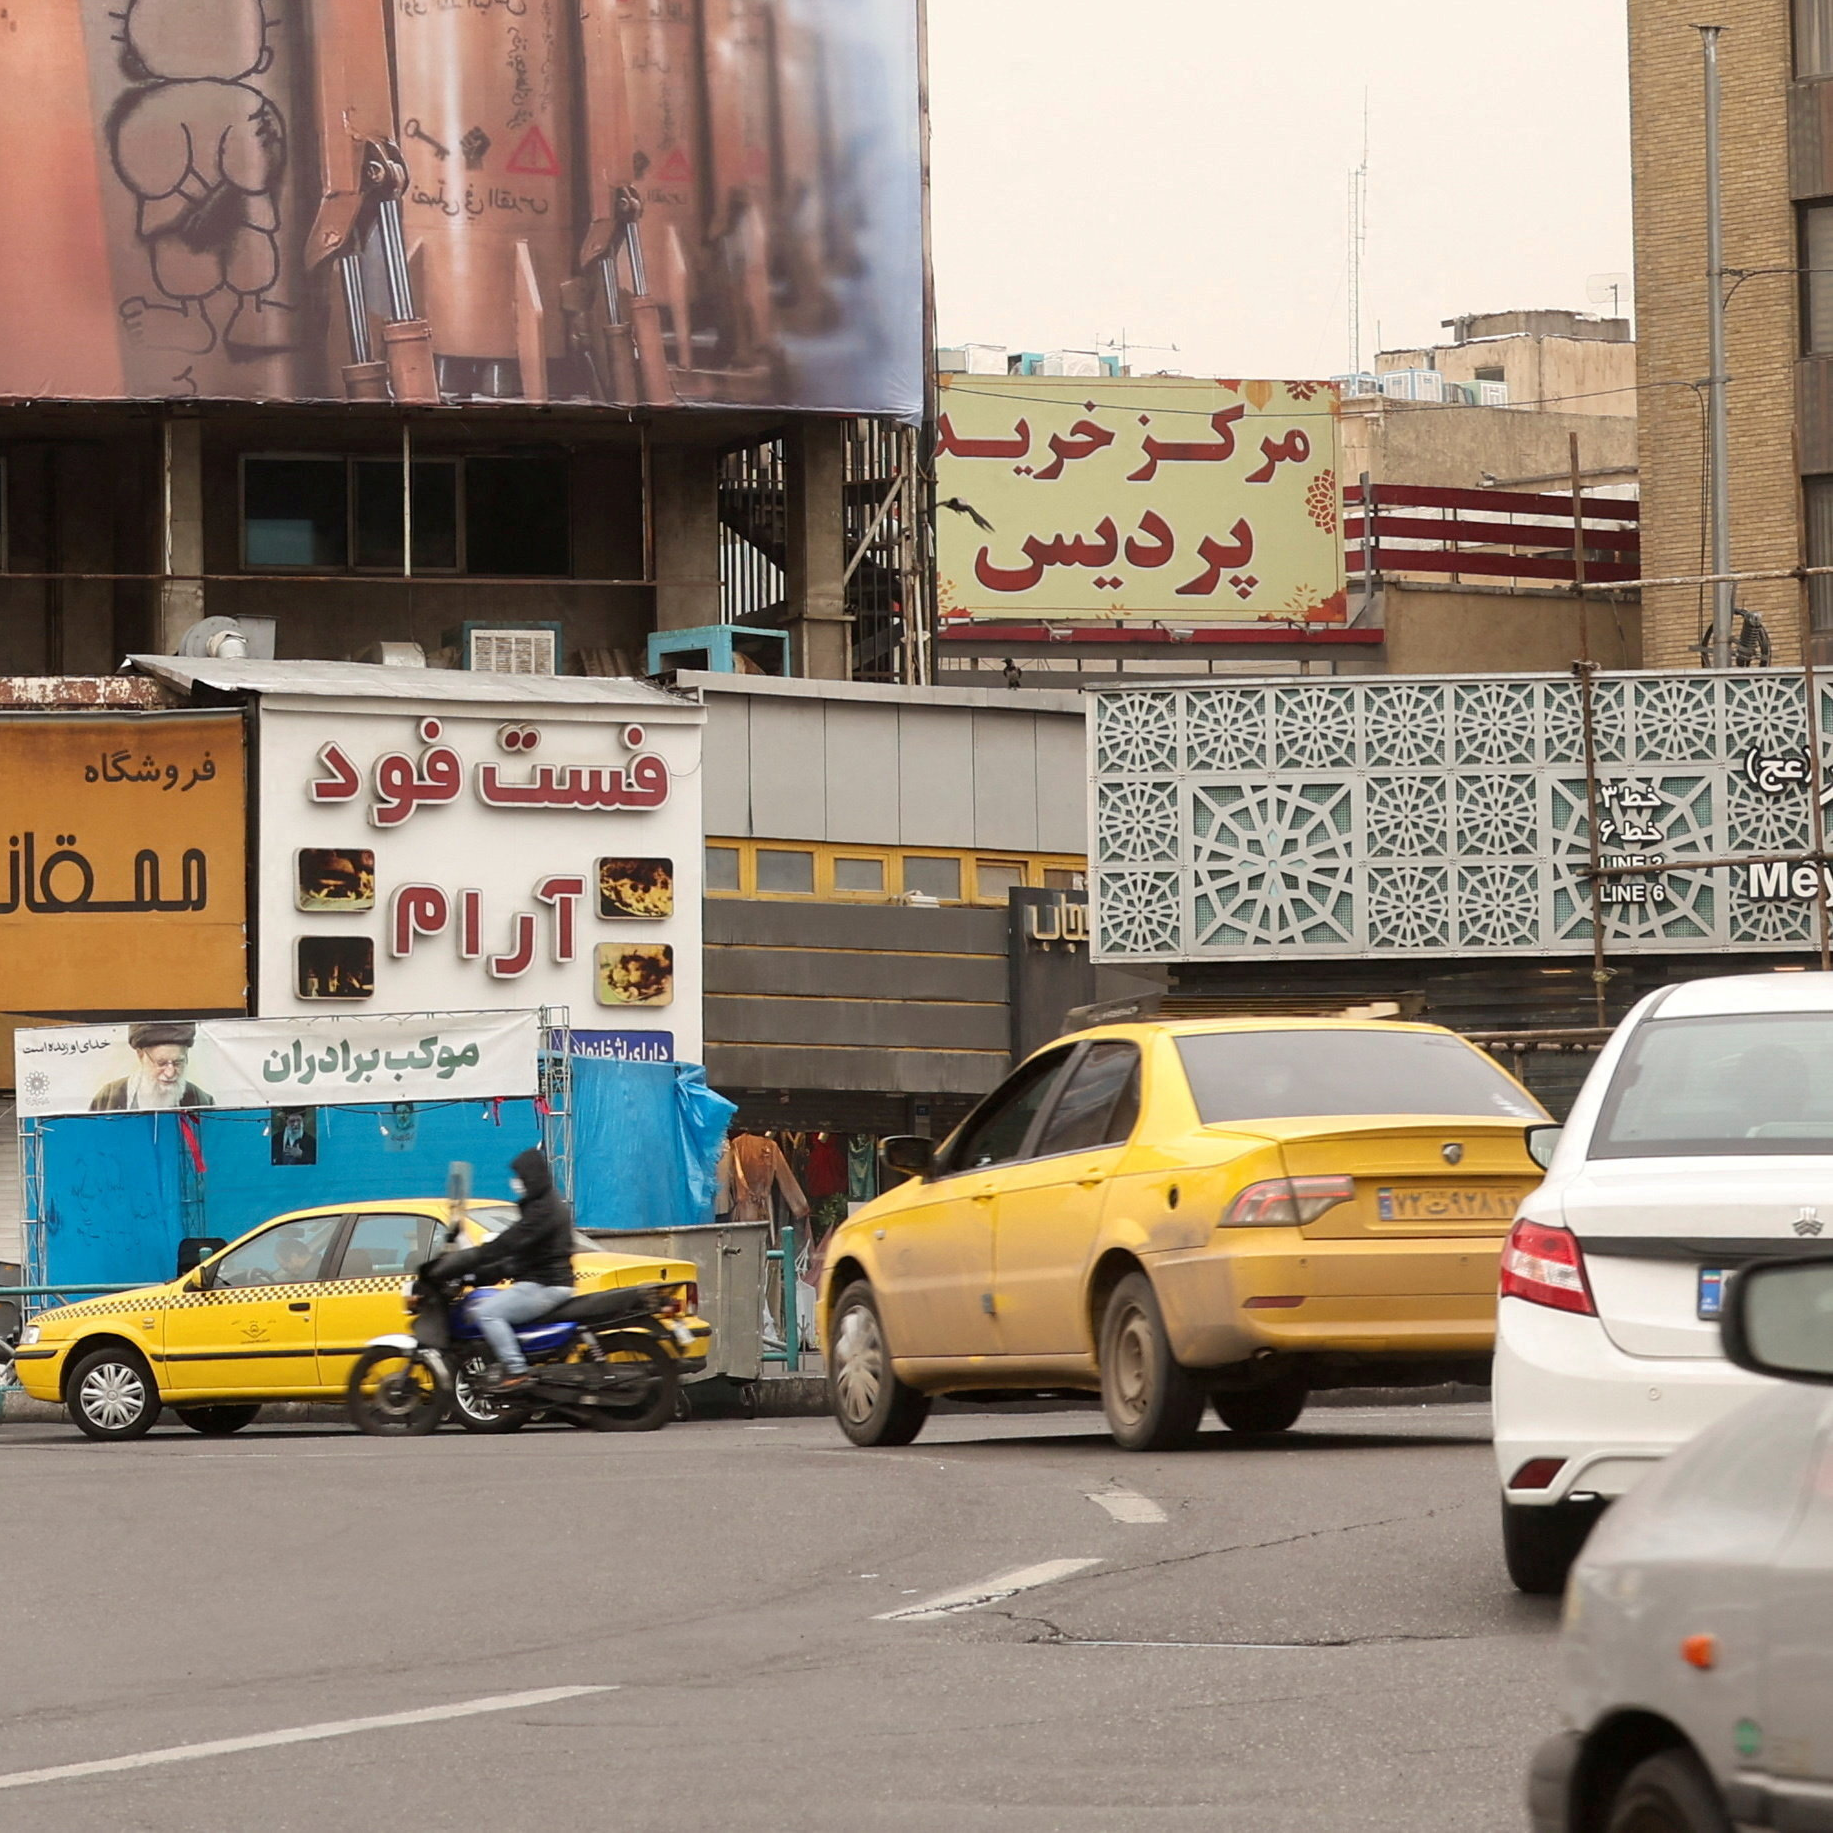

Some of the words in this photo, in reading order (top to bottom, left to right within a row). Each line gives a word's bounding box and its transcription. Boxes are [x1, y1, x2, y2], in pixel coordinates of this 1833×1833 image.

[934, 401, 1115, 480] خرید
[1127, 403, 1311, 484] مرکز
[974, 507, 1255, 600] پردیس
[84, 749, 217, 792] فروشگاه
[308, 716, 463, 828] فود
[478, 723, 670, 810] فست
[1600, 785, 1618, 809] ۳
[1619, 786, 1663, 808] خط
[1599, 819, 1616, 844] ۶
[1619, 820, 1664, 843] خط
[1599, 885, 1646, 903] LINE
[1652, 884, 1665, 903] 6
[388, 874, 588, 978] آرام
[22, 1042, 47, 1054] است
[263, 1038, 380, 1086] برادران
[384, 1037, 480, 1082] موکب
